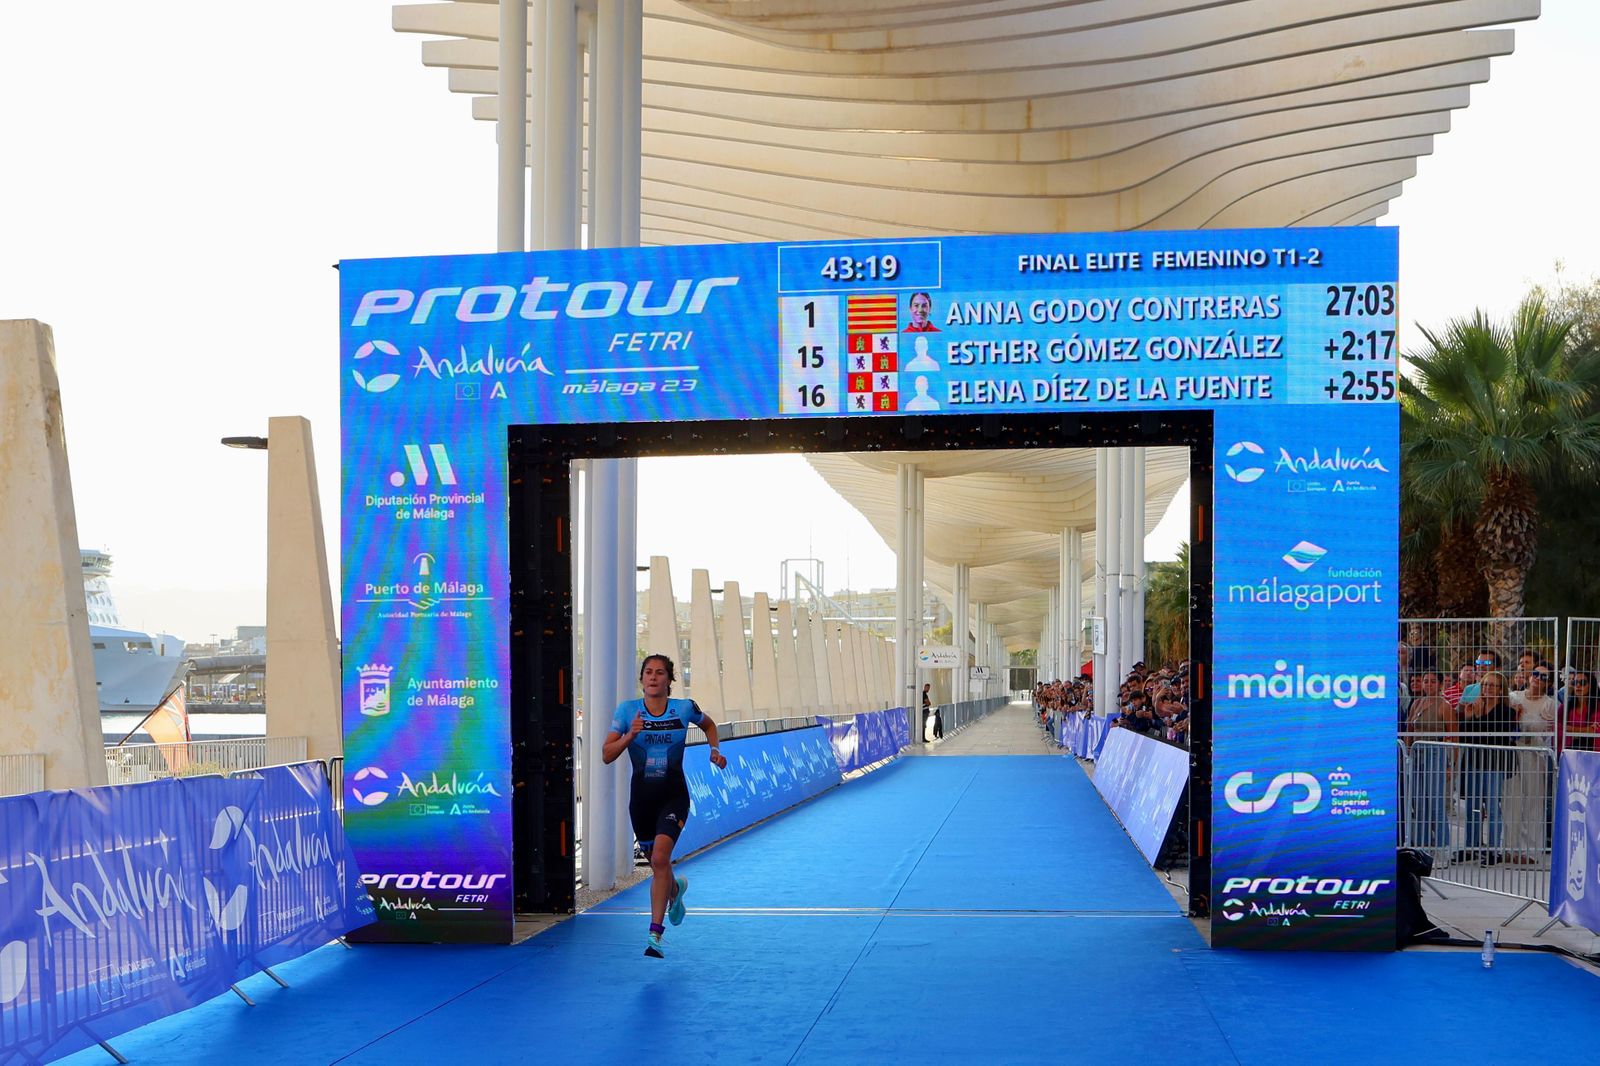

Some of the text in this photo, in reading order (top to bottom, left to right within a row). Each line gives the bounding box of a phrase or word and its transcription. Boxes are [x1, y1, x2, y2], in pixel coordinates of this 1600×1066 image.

[821, 255, 898, 280] 43:19
[1018, 248, 1321, 272] FINAL ELITE FEMENINO T1-2
[946, 294, 1281, 325] ANNA GODOY CONTRERAS
[1326, 285, 1395, 316] 27:03
[804, 301, 815, 328] 1
[608, 331, 693, 352] FETRI
[947, 329, 1283, 364] ESTHER GÓMEZ GONZÁLEZ
[1324, 330, 1396, 361] +2:17
[413, 342, 555, 380] Andalucía
[798, 346, 824, 368] 15
[562, 378, 698, 396] málaga 23
[798, 384, 825, 407] 16
[949, 374, 1272, 404] ELENA DÍEZ DE LA FUENTE
[1324, 371, 1395, 401] +2:55
[1273, 446, 1389, 473] Andalucía
[365, 493, 485, 508] Diputación Provincial
[396, 508, 454, 520] de Málaga
[1328, 566, 1382, 578] fundación
[365, 582, 484, 595] Puerto de Málaga
[1229, 576, 1382, 610] málagaport
[407, 677, 498, 695] Ayuntamiento
[407, 693, 475, 709] de Málaga
[396, 771, 502, 798] Andalucía
[1331, 788, 1367, 800] Consejo
[1331, 797, 1370, 807] Superior
[1331, 806, 1386, 816] de Deportes
[379, 897, 435, 911] Andalucía
[455, 894, 489, 903] FETRI
[1333, 900, 1370, 910] FETRI
[1249, 901, 1311, 918] Andalucía
